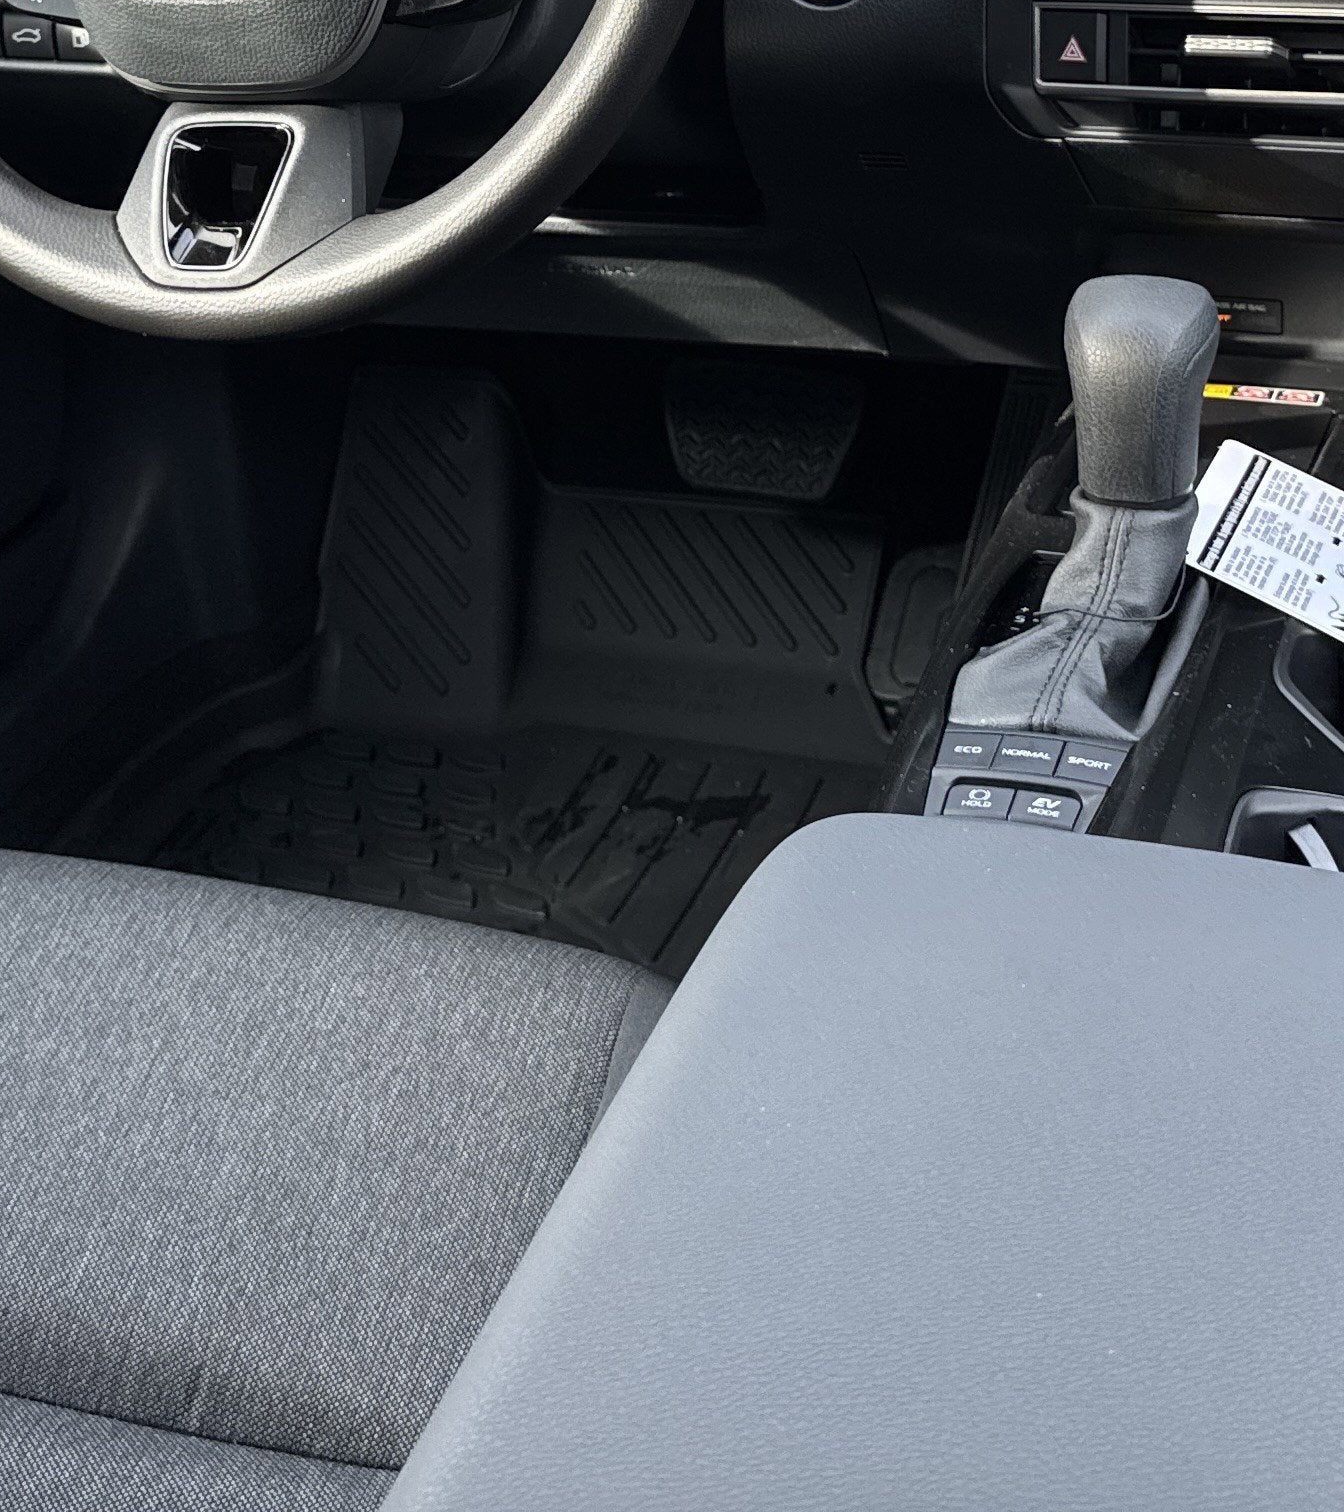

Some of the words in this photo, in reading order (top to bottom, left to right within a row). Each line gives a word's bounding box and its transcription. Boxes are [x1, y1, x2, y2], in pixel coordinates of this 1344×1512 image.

[954, 745, 983, 754] ECO
[1001, 747, 1052, 761] NORMAL
[1067, 756, 1112, 771] SPORT
[961, 799, 992, 808] HOLD
[1031, 797, 1061, 808] EV
[1027, 806, 1060, 818] MODE
